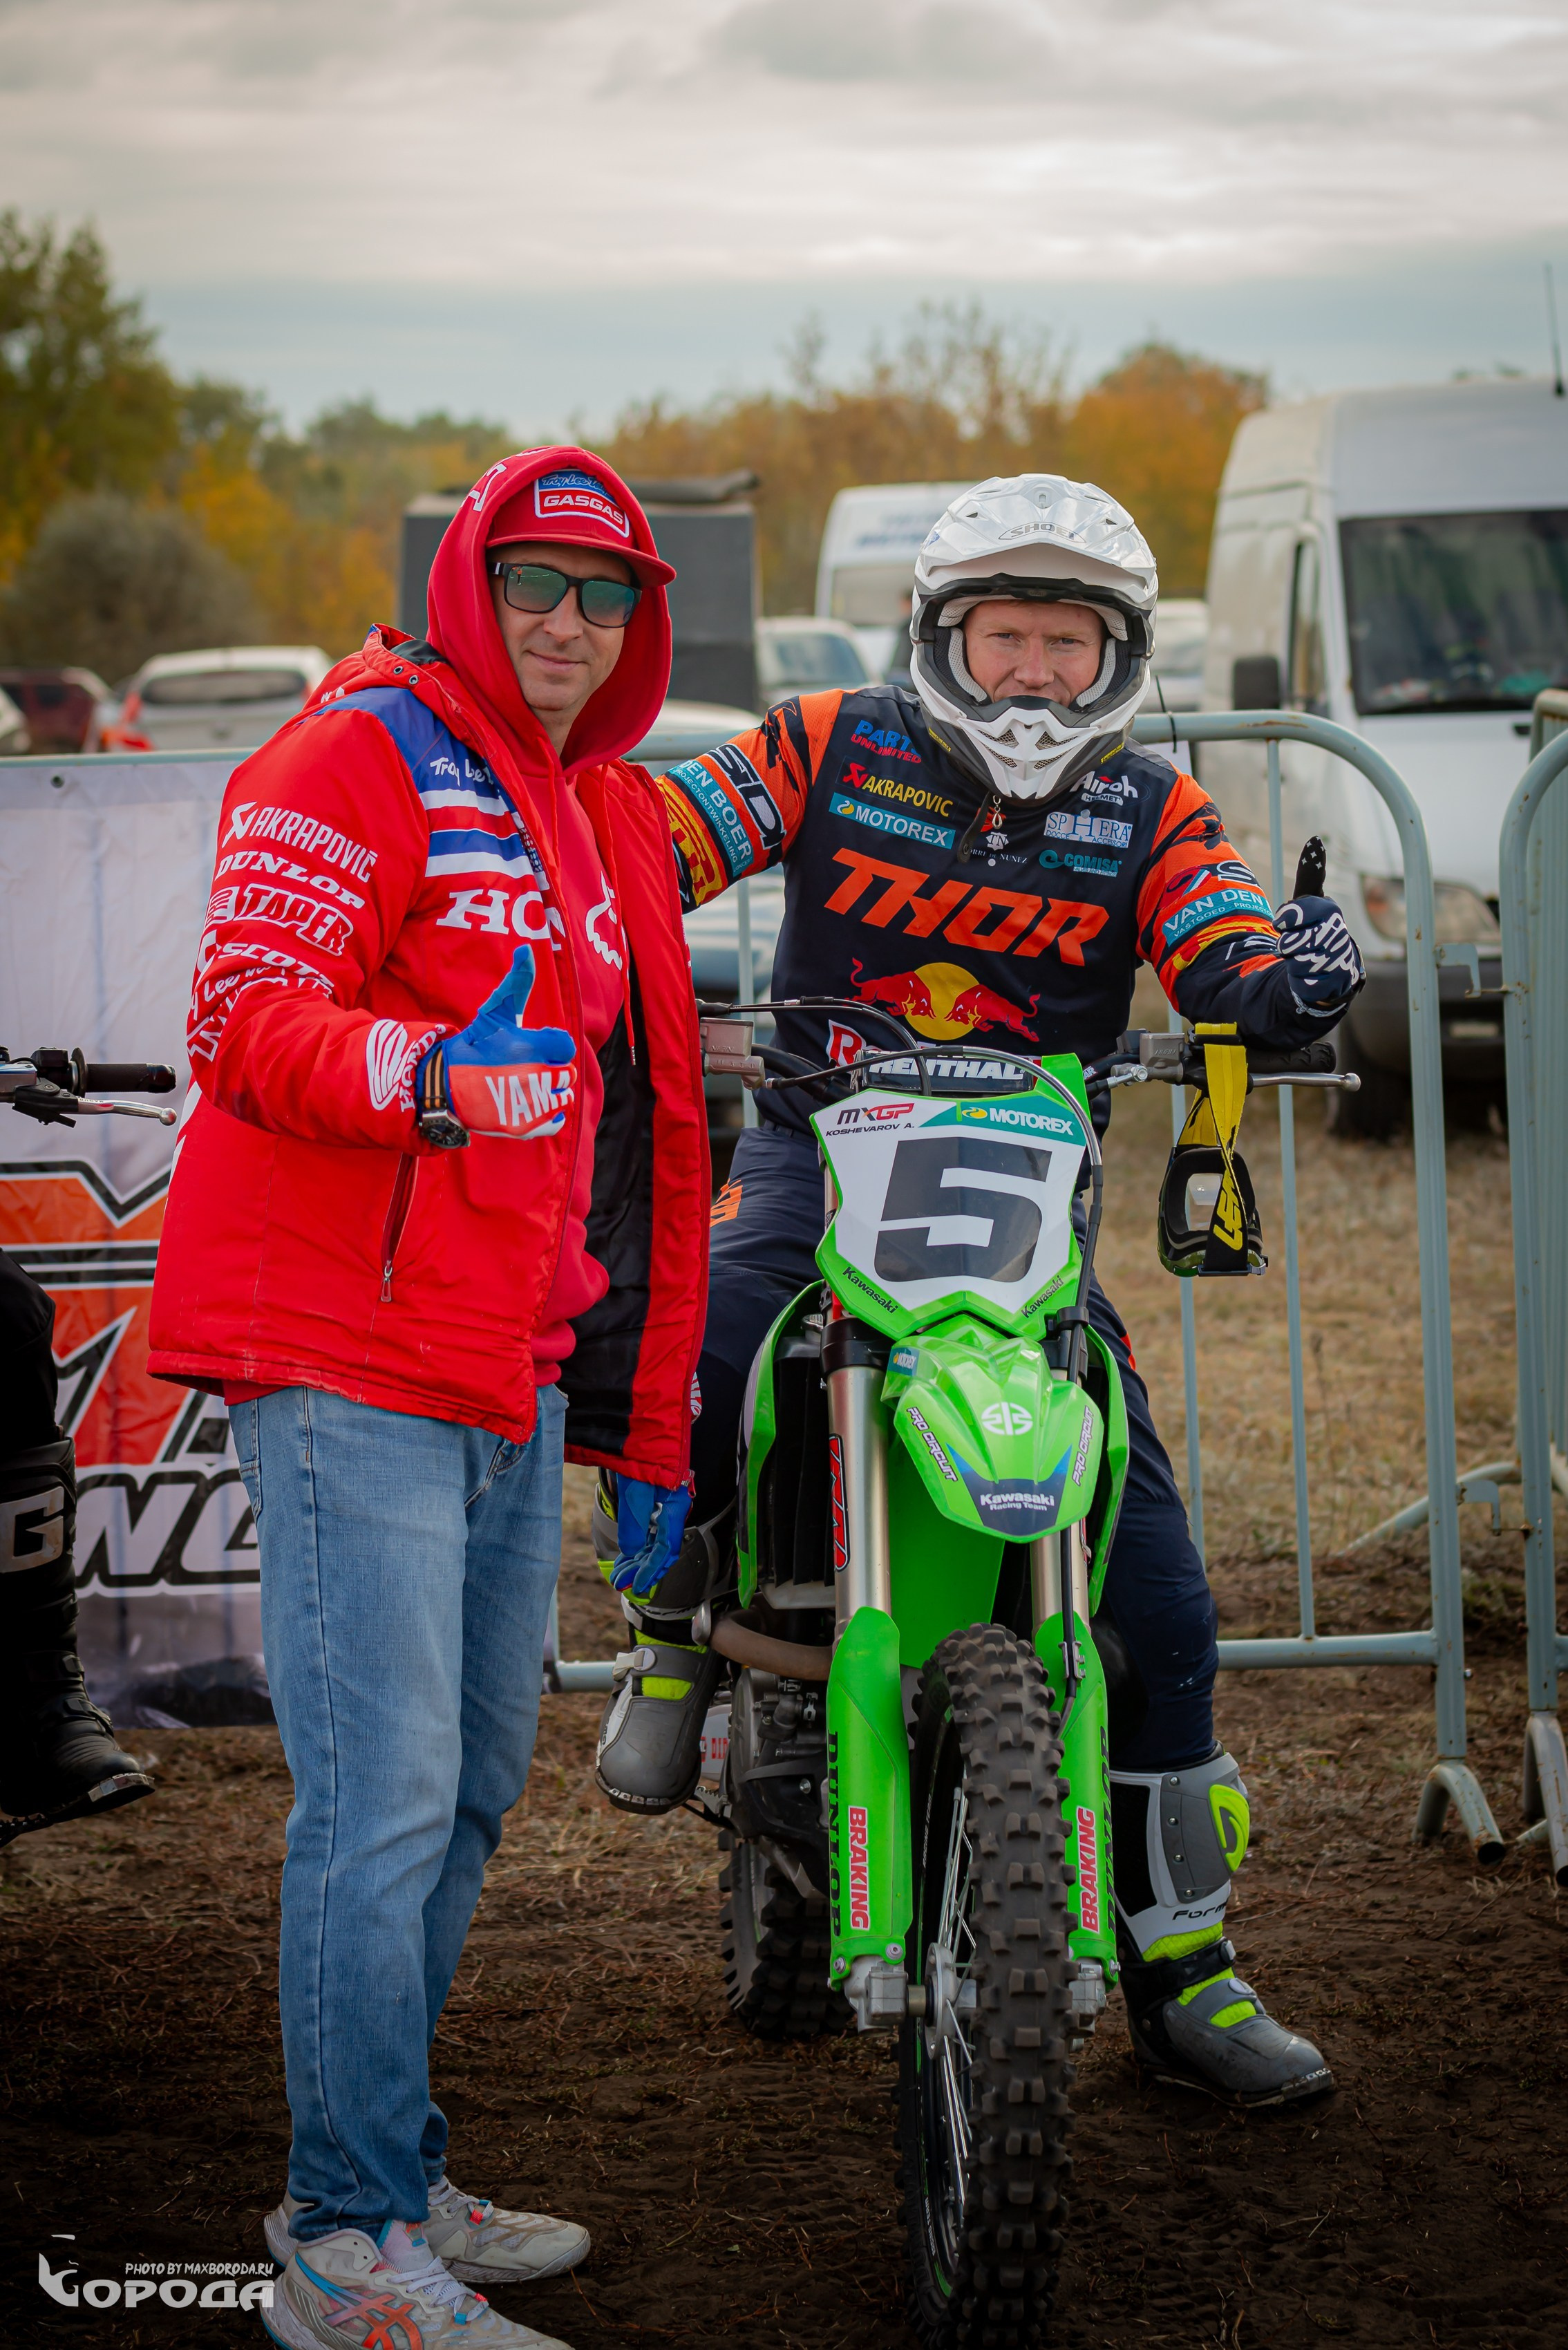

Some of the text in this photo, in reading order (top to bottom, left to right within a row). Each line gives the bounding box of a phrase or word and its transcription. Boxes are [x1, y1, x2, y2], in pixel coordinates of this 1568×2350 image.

[542, 474, 589, 487] Troy Lee
[544, 495, 623, 525] GASGAS
[1010, 523, 1075, 539] SHOEI
[851, 733, 922, 764] UNLIMITED
[430, 757, 460, 787] Troy
[1069, 771, 1138, 798] Airoh
[862, 776, 954, 817] AKRAPOVIC
[710, 789, 752, 861] BOER
[855, 805, 949, 847] MOTOREX
[1046, 830, 1070, 840] DOCCE
[1092, 836, 1128, 848] ACCESSORI
[1064, 853, 1119, 873] COMISA
[214, 851, 366, 910] DUNLOP
[238, 884, 354, 957] TAPER
[824, 847, 1110, 967] THOR
[1164, 896, 1214, 932] VAN
[1221, 889, 1264, 906] DEN
[1174, 907, 1226, 937] VASTGOED
[204, 974, 240, 1002] Lee
[837, 1103, 915, 1125] MXGP
[990, 1107, 1075, 1136] MOTOREX
[825, 1123, 900, 1137] KOSHEVAROV
[874, 1136, 1052, 1283] 5
[842, 1266, 898, 1315] Kawasaki
[1021, 1274, 1065, 1319] Kawasaki
[907, 1407, 958, 1482] PRO CIRCUIT
[1072, 1405, 1094, 1487] PRO CIRCUIT
[980, 1492, 1055, 1507] Kawasaki
[990, 1502, 1048, 1512] Racing Team
[849, 1805, 869, 1930] BRAKING
[1076, 1805, 1099, 1934] BRAKING
